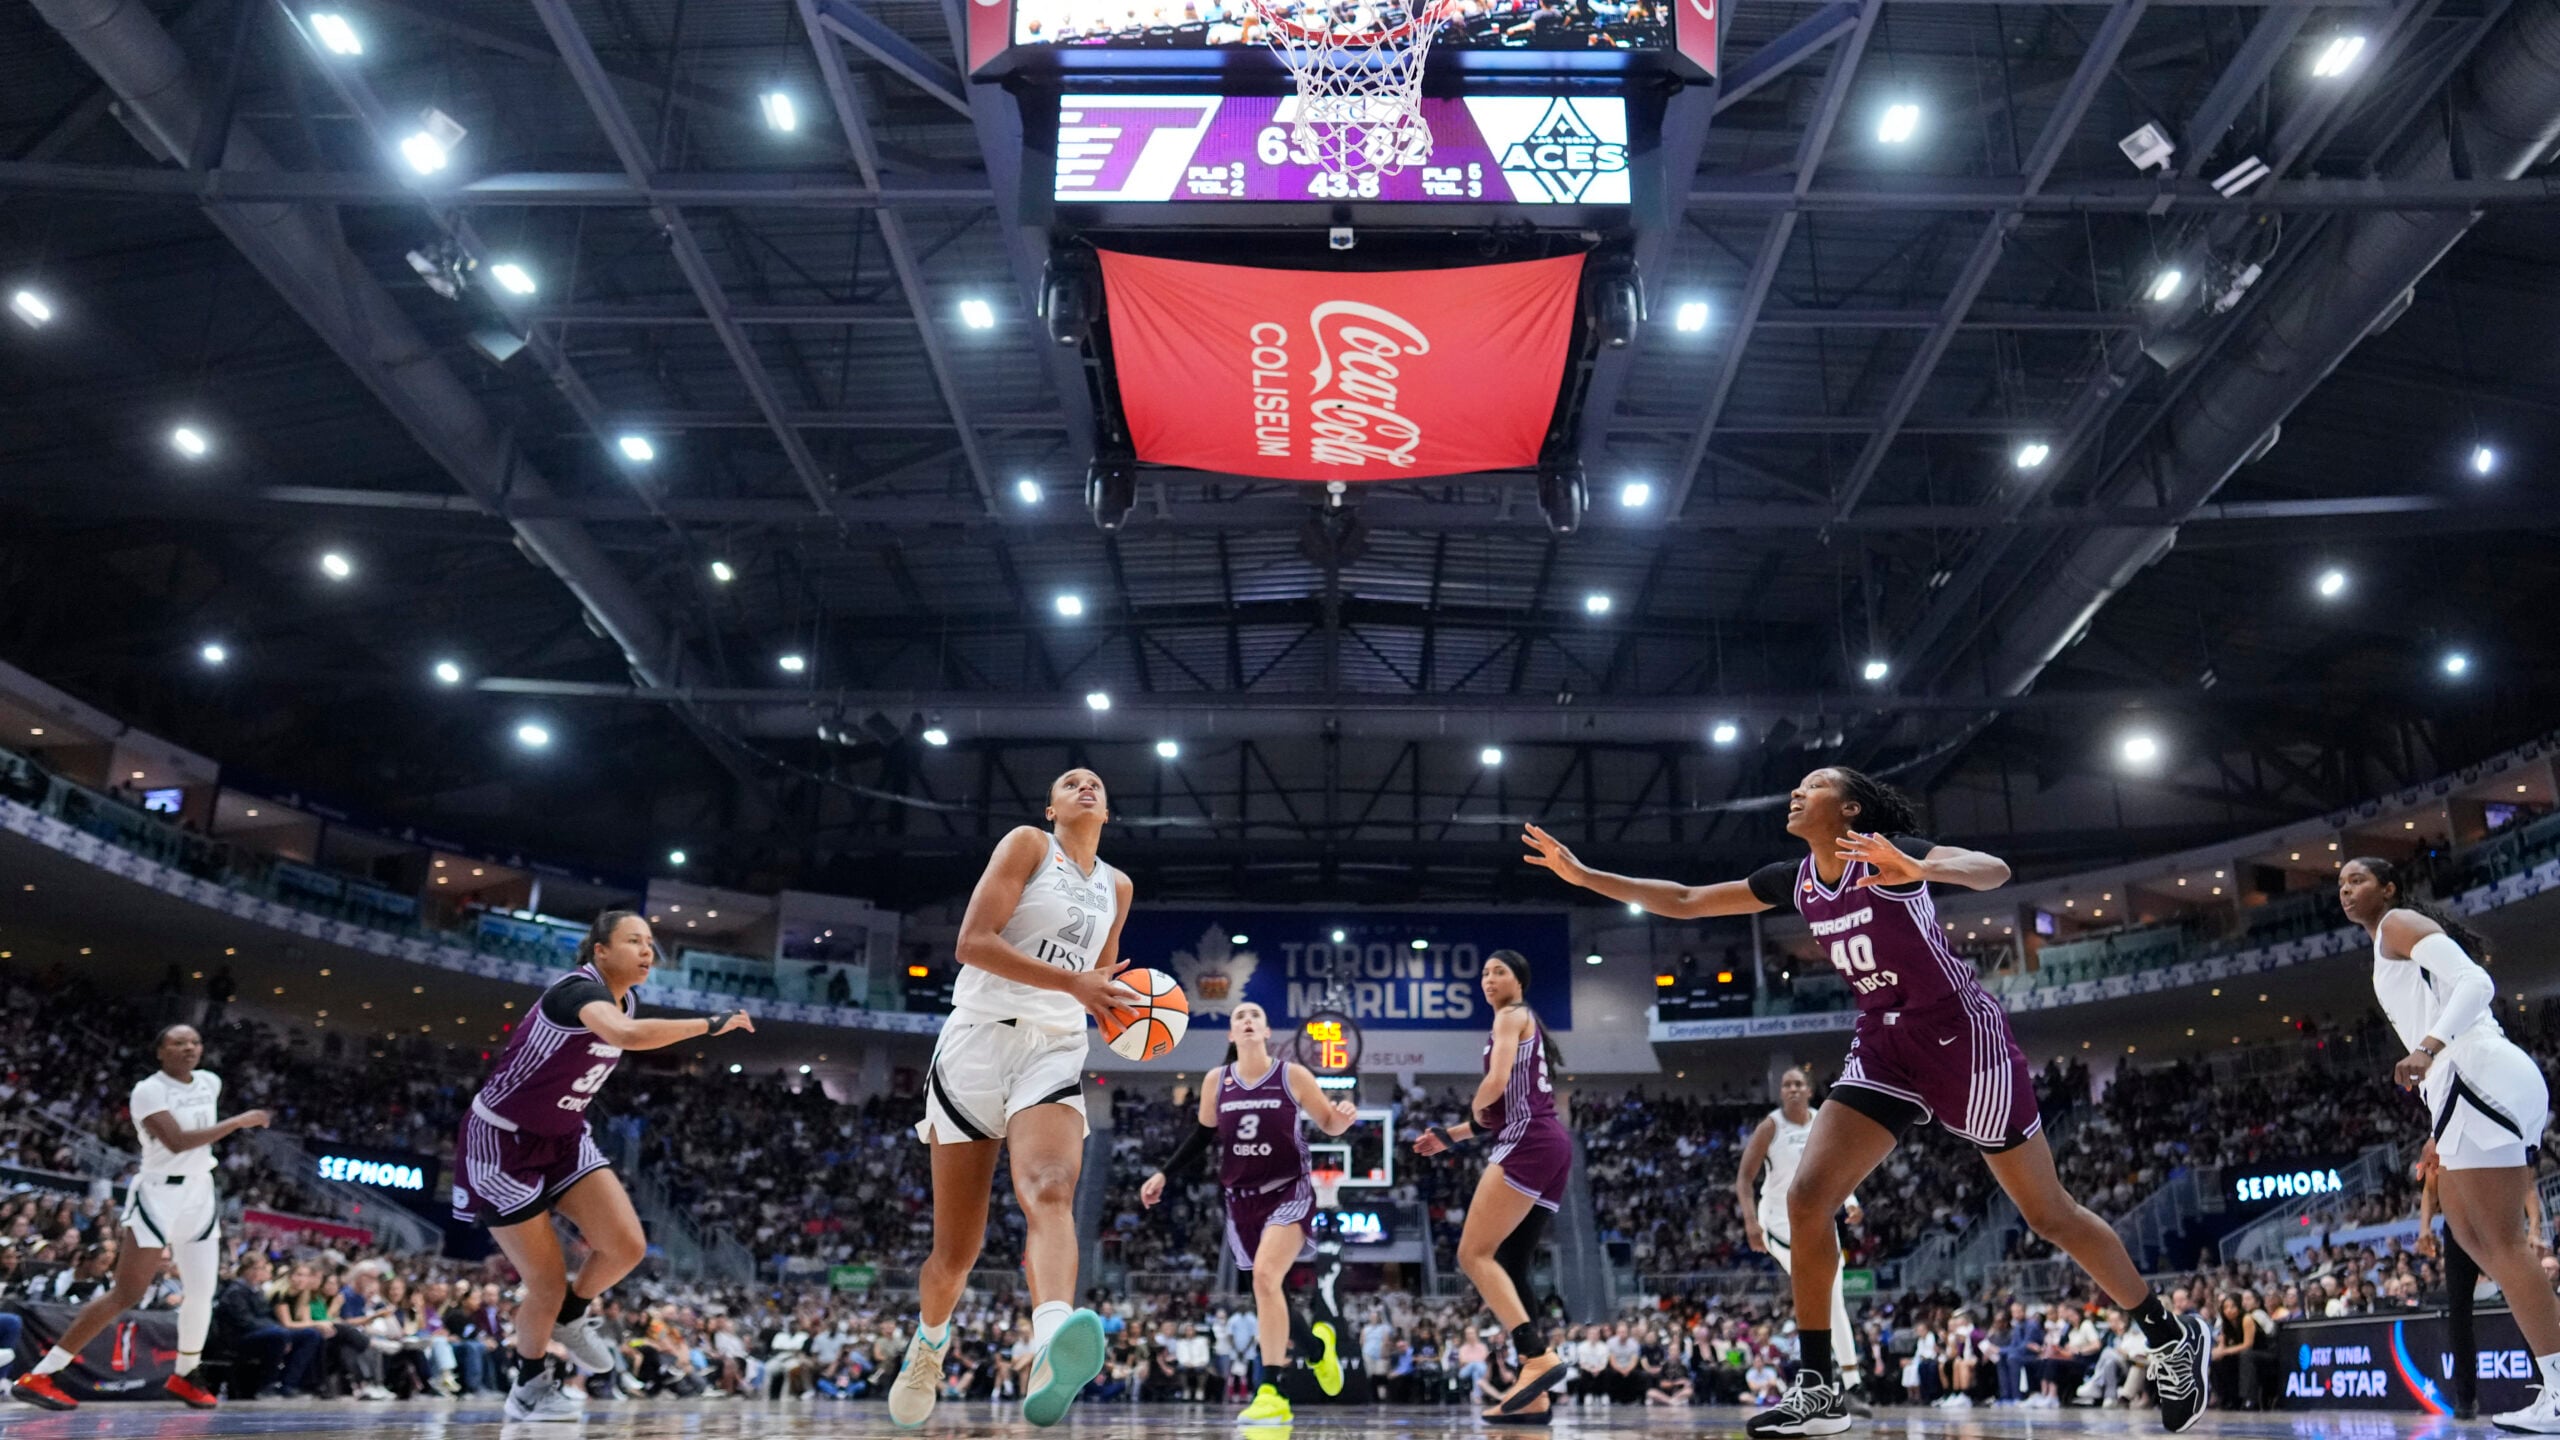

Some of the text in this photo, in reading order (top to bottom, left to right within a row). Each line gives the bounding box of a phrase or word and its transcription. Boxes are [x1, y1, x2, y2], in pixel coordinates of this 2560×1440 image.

[1363, 126, 1428, 165] 82
[1501, 144, 1627, 171] ACES
[1230, 161, 1245, 179] 3
[1307, 171, 1380, 198] 43.8
[1230, 179, 1245, 197] 2
[1467, 181, 1483, 198] 3
[1249, 321, 1291, 458] COLISEUM
[1308, 299, 1431, 469] Coca-Cola
[1053, 878, 1109, 913] ACES
[1057, 905, 1097, 950] 21
[1809, 906, 1874, 936] TORONTO
[1280, 942, 1480, 979] TORONTO
[1830, 934, 1877, 976] 40
[1668, 1023, 1745, 1038] Developing
[1791, 1018, 1829, 1029] since
[1322, 1040, 1348, 1068] 16
[1220, 1099, 1282, 1113] TORONTO
[1236, 1114, 1260, 1140] 3
[318, 1155, 424, 1191] SEPHORA
[2236, 1168, 2343, 1202] SEPHORA
[2310, 1345, 2371, 1367] AT&T WNBA
